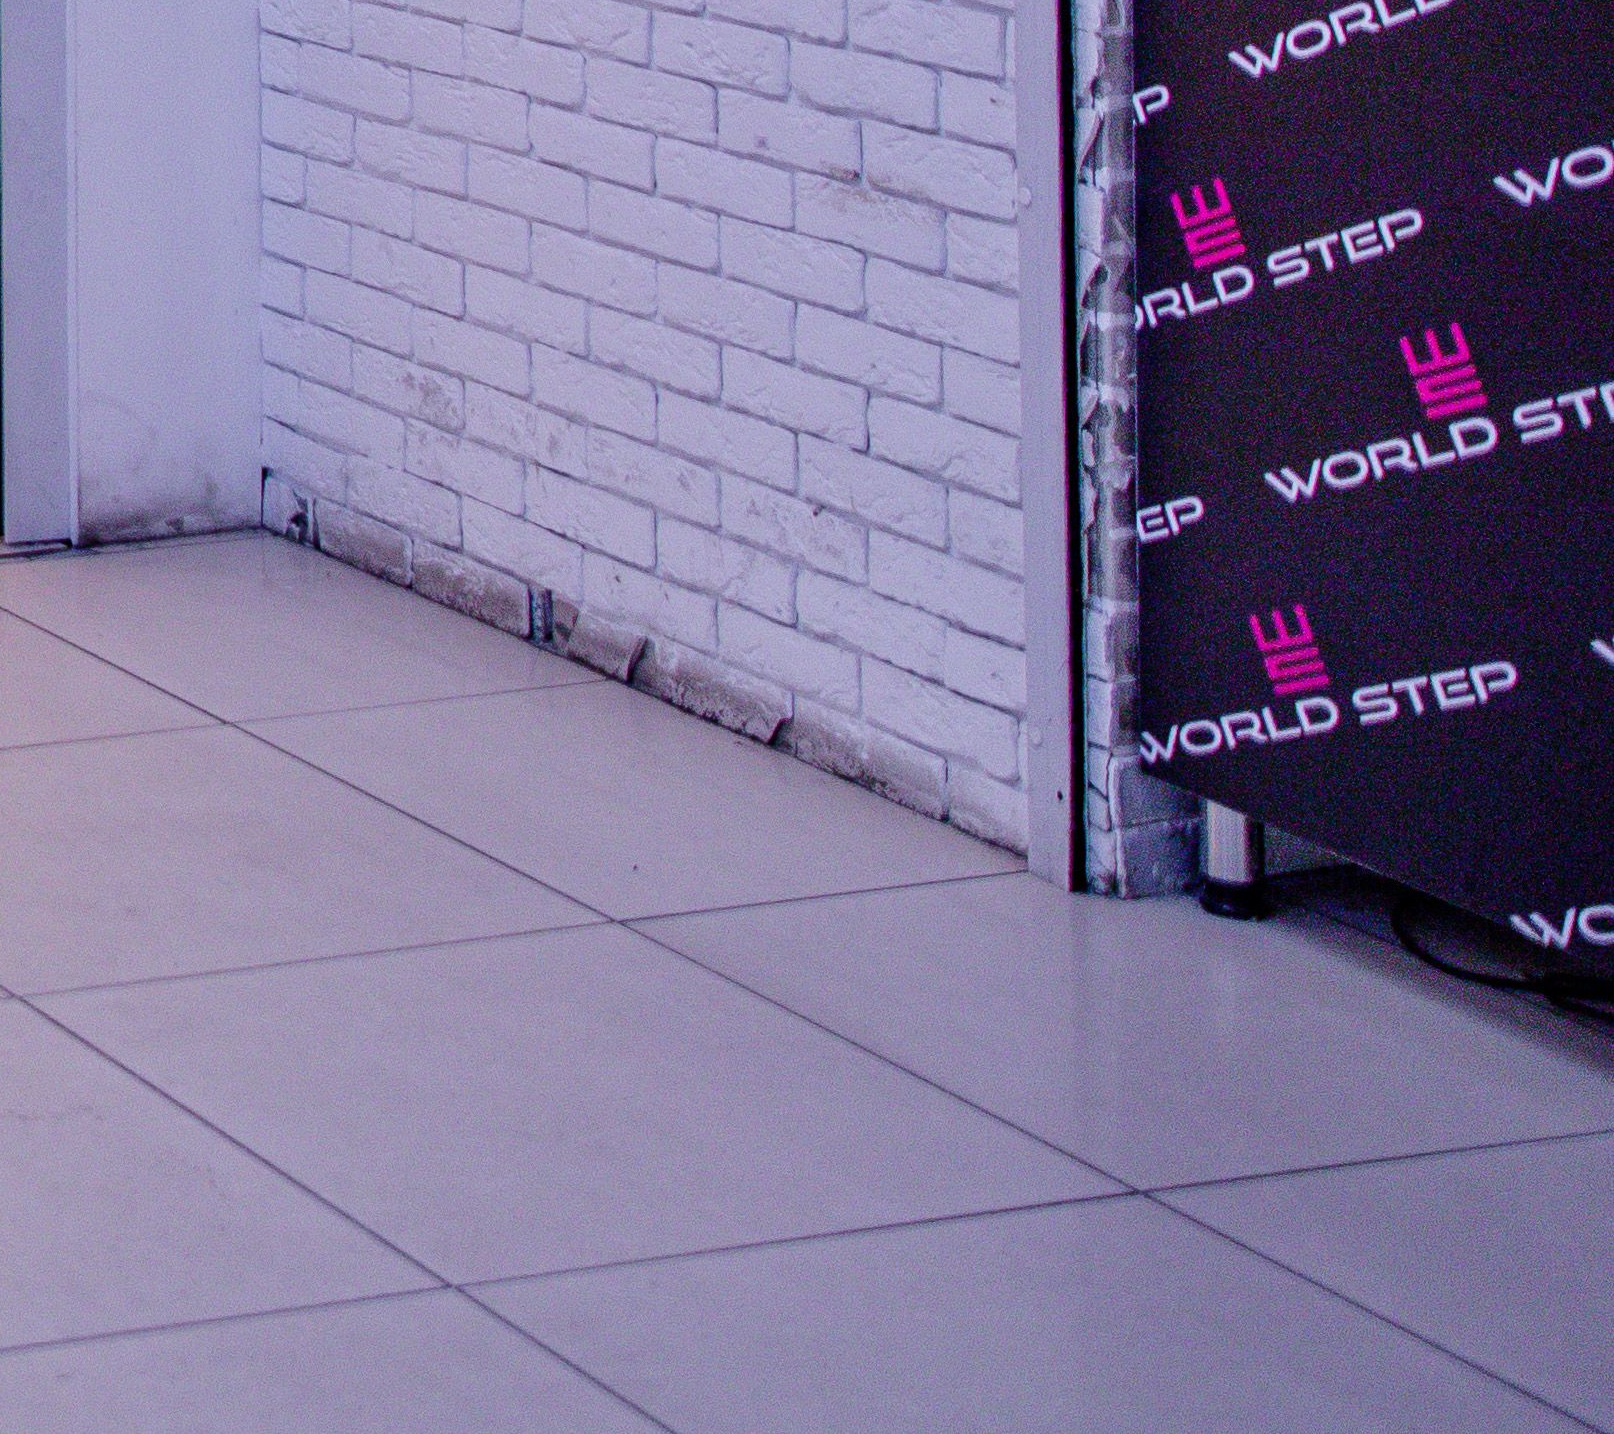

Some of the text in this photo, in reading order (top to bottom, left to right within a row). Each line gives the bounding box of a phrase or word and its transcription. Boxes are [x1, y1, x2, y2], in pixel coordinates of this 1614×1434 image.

[1266, 208, 1423, 288] STEP
[1264, 416, 1498, 503] WORLD
[1351, 661, 1517, 724] STEP
